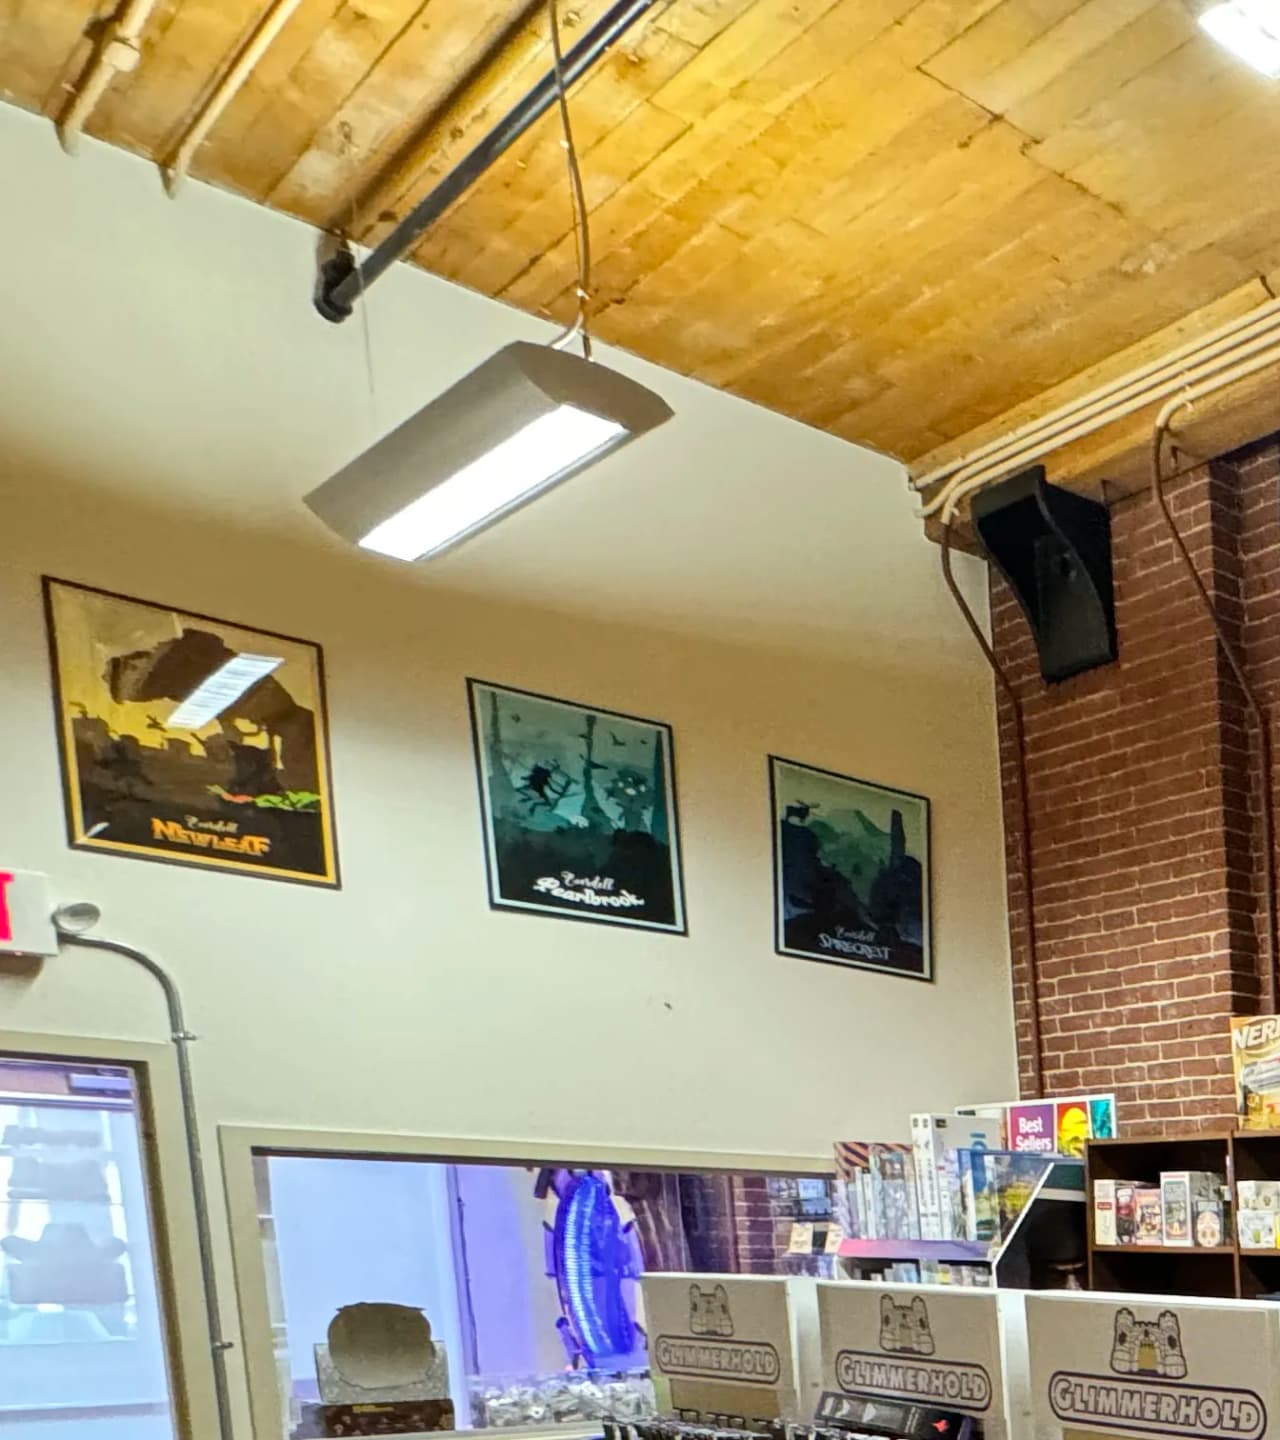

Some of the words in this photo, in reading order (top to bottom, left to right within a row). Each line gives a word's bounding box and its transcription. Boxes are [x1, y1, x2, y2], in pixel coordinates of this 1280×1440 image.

[1015, 1135, 1053, 1151] Sellers
[1019, 1117, 1044, 1134] Best
[659, 1340, 775, 1377] GLIMMERHOLD
[840, 1355, 987, 1404] GLIMMERHOLD
[1053, 1378, 1260, 1434] GLIMMERHOLD
